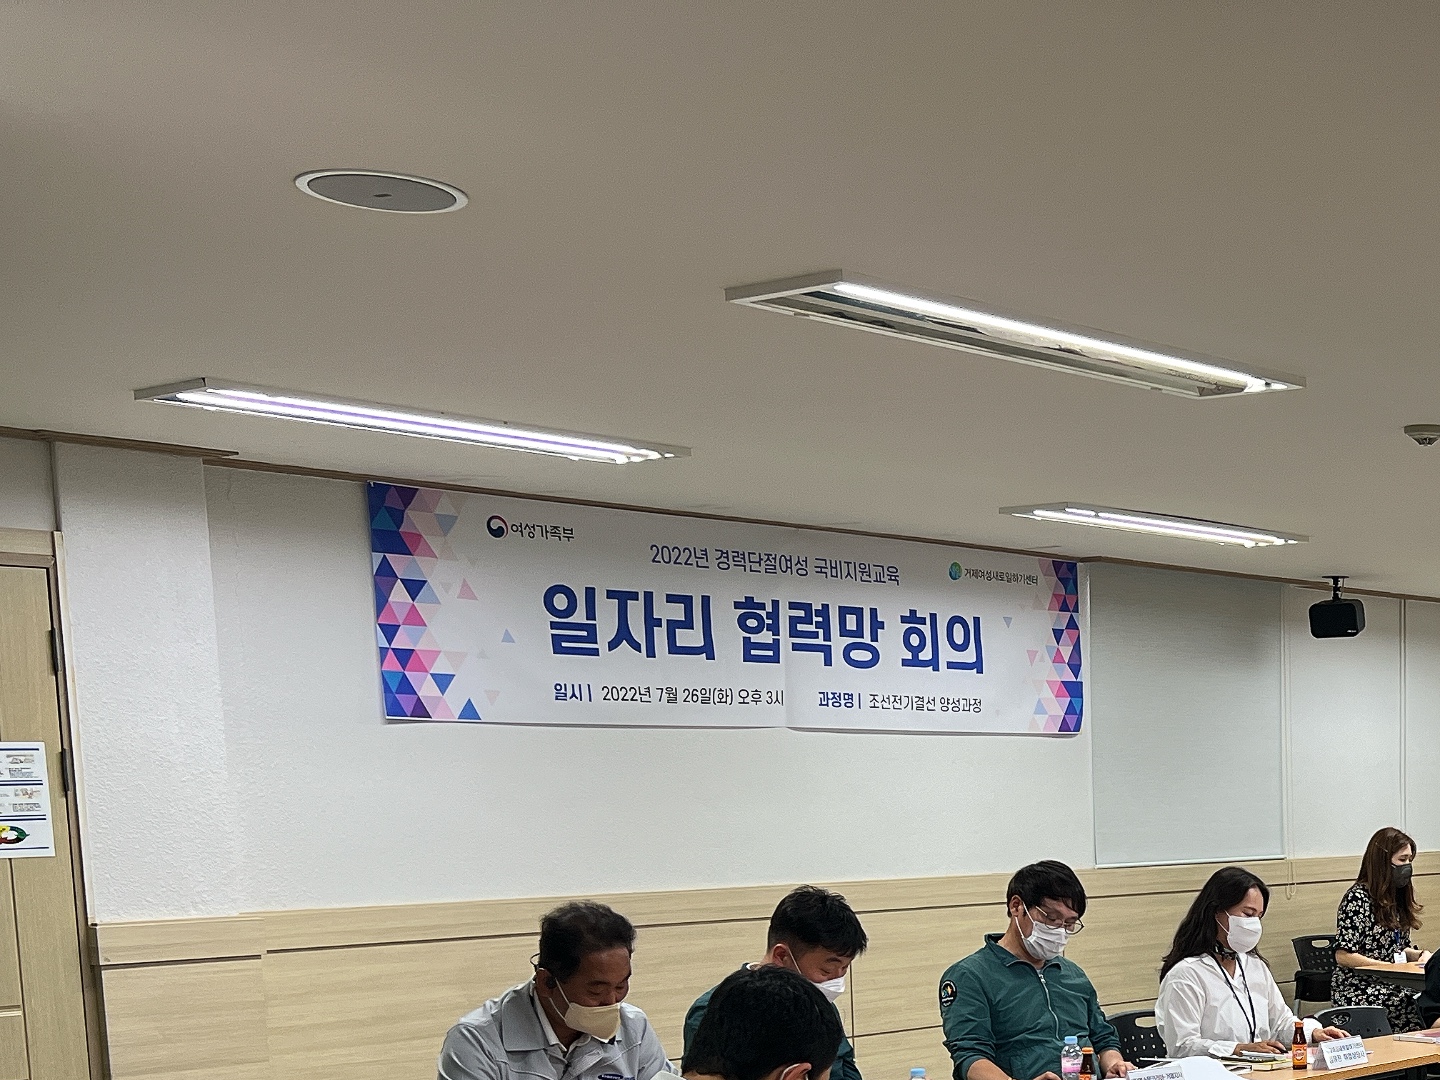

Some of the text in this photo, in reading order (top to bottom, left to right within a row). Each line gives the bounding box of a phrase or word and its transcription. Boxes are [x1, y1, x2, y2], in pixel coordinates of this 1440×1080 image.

[510, 522, 575, 542] 여성가족부
[650, 545, 900, 587] 2022년 경력단절여성 국비지원교육
[542, 583, 985, 675] 일자리 협력망 회의
[601, 686, 652, 704] 2022년
[655, 686, 678, 704] 7월
[682, 687, 733, 706] 26일(화)
[737, 688, 762, 706] 오후
[766, 689, 784, 706] 3시
[869, 693, 936, 712] 조선전기결선
[939, 696, 982, 714] 양성과정
